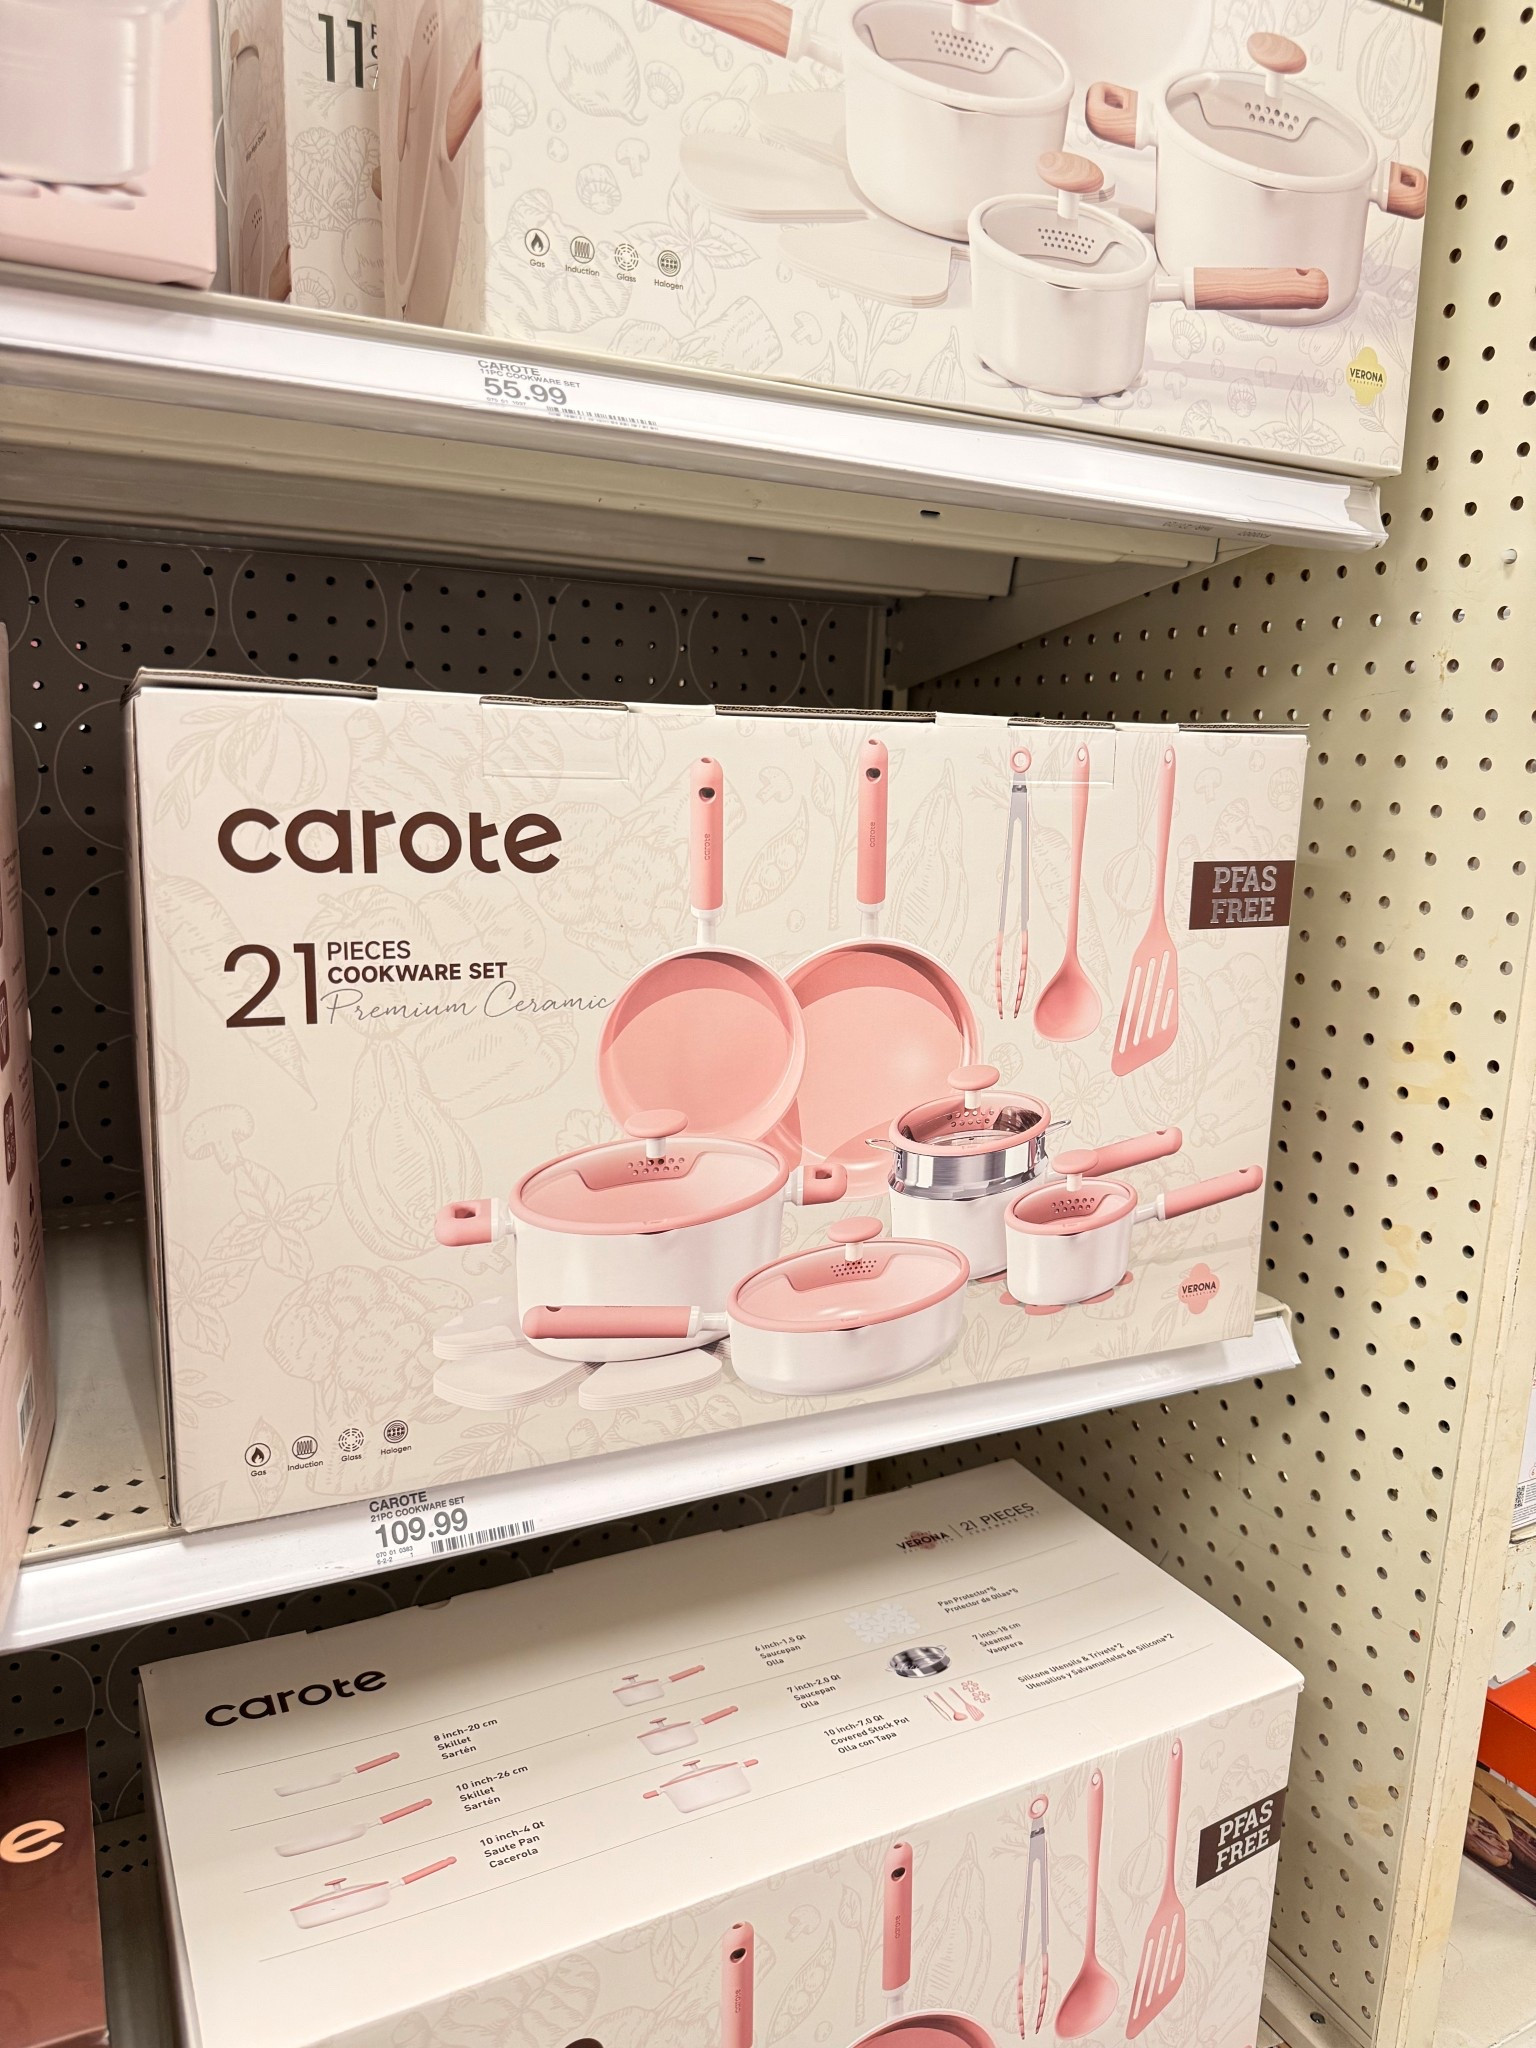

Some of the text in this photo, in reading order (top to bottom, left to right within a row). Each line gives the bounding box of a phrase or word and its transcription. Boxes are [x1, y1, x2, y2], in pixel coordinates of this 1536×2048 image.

[318, 13, 364, 89] 11
[529, 259, 546, 269] Gas
[565, 264, 600, 277] Induction
[616, 272, 637, 283] Glass
[654, 279, 684, 291] Halogen
[477, 359, 541, 377] CAROTE
[1350, 367, 1384, 383] VERONA
[480, 368, 581, 389] 11PC COOKWARE SET
[484, 377, 567, 406] 55.99
[217, 807, 562, 874] carote
[1212, 865, 1278, 893] PFAS
[1210, 896, 1275, 924] FREE
[327, 940, 411, 961] PIECES
[327, 962, 508, 984] COOKWARE SET
[223, 942, 318, 1028] 21
[319, 980, 617, 1025] Premium Ceramic
[1182, 1280, 1217, 1294] VERONA
[341, 1453, 362, 1462] Glass
[380, 1444, 412, 1456] Halogen
[250, 1469, 267, 1477] Gas
[287, 1459, 324, 1472] Induction
[369, 1491, 428, 1513] CAROTE
[370, 1495, 466, 1523] 21PC COOKWARE SET
[375, 1507, 468, 1548] 109.99
[896, 1531, 950, 1550] VERONA
[960, 1519, 978, 1531] 21
[979, 1502, 1034, 1525] PIECES
[937, 1599, 954, 1607] Pan
[944, 1600, 980, 1614] Protector
[979, 1625, 1008, 1639] inch-18
[1008, 1622, 1021, 1630] cm
[980, 1633, 1013, 1648] Steamer
[759, 1644, 801, 1660] Saucepan
[761, 1636, 796, 1651] inch-1.5
[796, 1633, 806, 1641] Qt
[766, 1658, 785, 1667] Olla
[1017, 1668, 1050, 1683] Silicone
[1049, 1658, 1082, 1673] Utensils
[1082, 1654, 1089, 1662] &
[1025, 1673, 1067, 1690] Utensilios
[1071, 1652, 1127, 1676] Salvamanteles
[1126, 1647, 1137, 1656] de
[794, 1676, 830, 1692] inch-2.0
[830, 1673, 841, 1681] Qt
[204, 1670, 387, 1727] carote
[793, 1685, 837, 1701] Saucepan
[800, 1699, 819, 1709] Olla
[433, 1718, 498, 1742] 8 inch-20 cm
[823, 1714, 884, 1737] 10 inch-7.0 Qt
[830, 1716, 910, 1746] Covered Stock Pot
[437, 1736, 471, 1751] Skillet
[441, 1745, 477, 1760] Sartén
[837, 1731, 897, 1754] Olla con Tapa
[455, 1765, 529, 1792] 10 inch-26 cm
[459, 1786, 495, 1802] Skillet
[463, 1796, 501, 1812] Sartén
[1218, 1799, 1274, 1847] PFAS
[479, 1820, 546, 1847] 10 inch-4 Qt
[484, 1835, 541, 1858] Saute Pan
[1215, 1824, 1271, 1873] FREE
[489, 1848, 539, 1868] Cacerola
